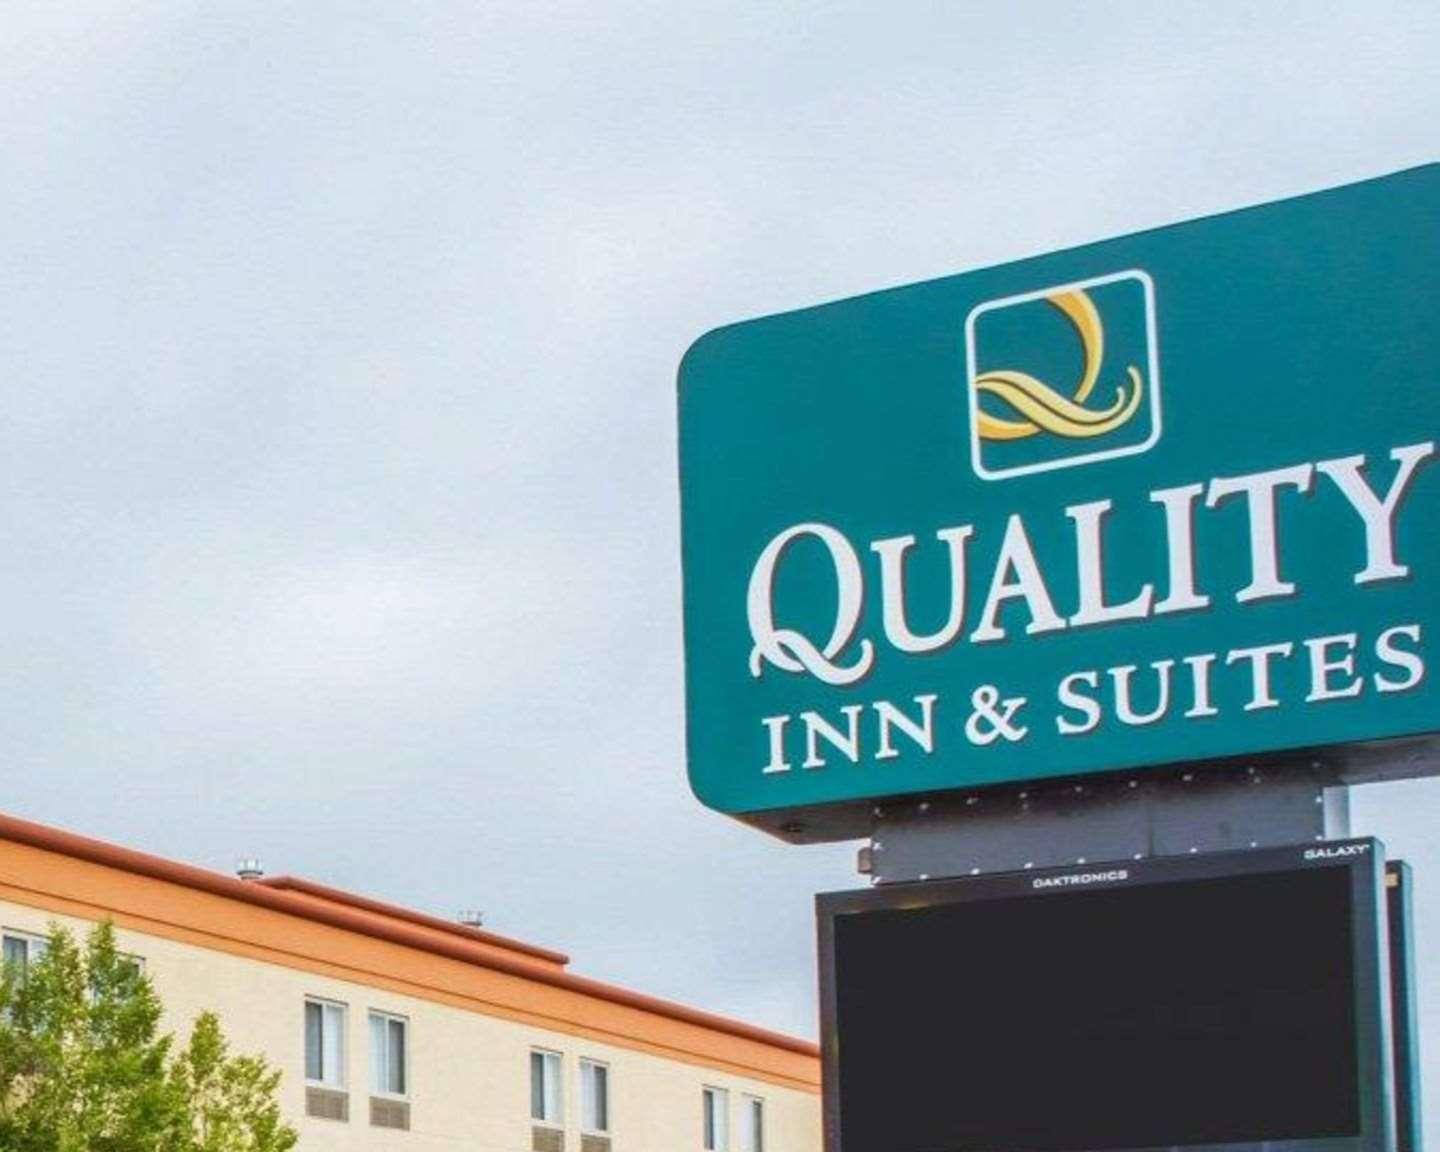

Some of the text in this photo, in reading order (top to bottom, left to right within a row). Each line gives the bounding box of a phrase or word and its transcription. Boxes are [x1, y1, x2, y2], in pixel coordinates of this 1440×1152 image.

[747, 442, 1435, 686] QUALITY
[762, 624, 1425, 775] INN & SUITES
[1303, 844, 1369, 860] GALAXY
